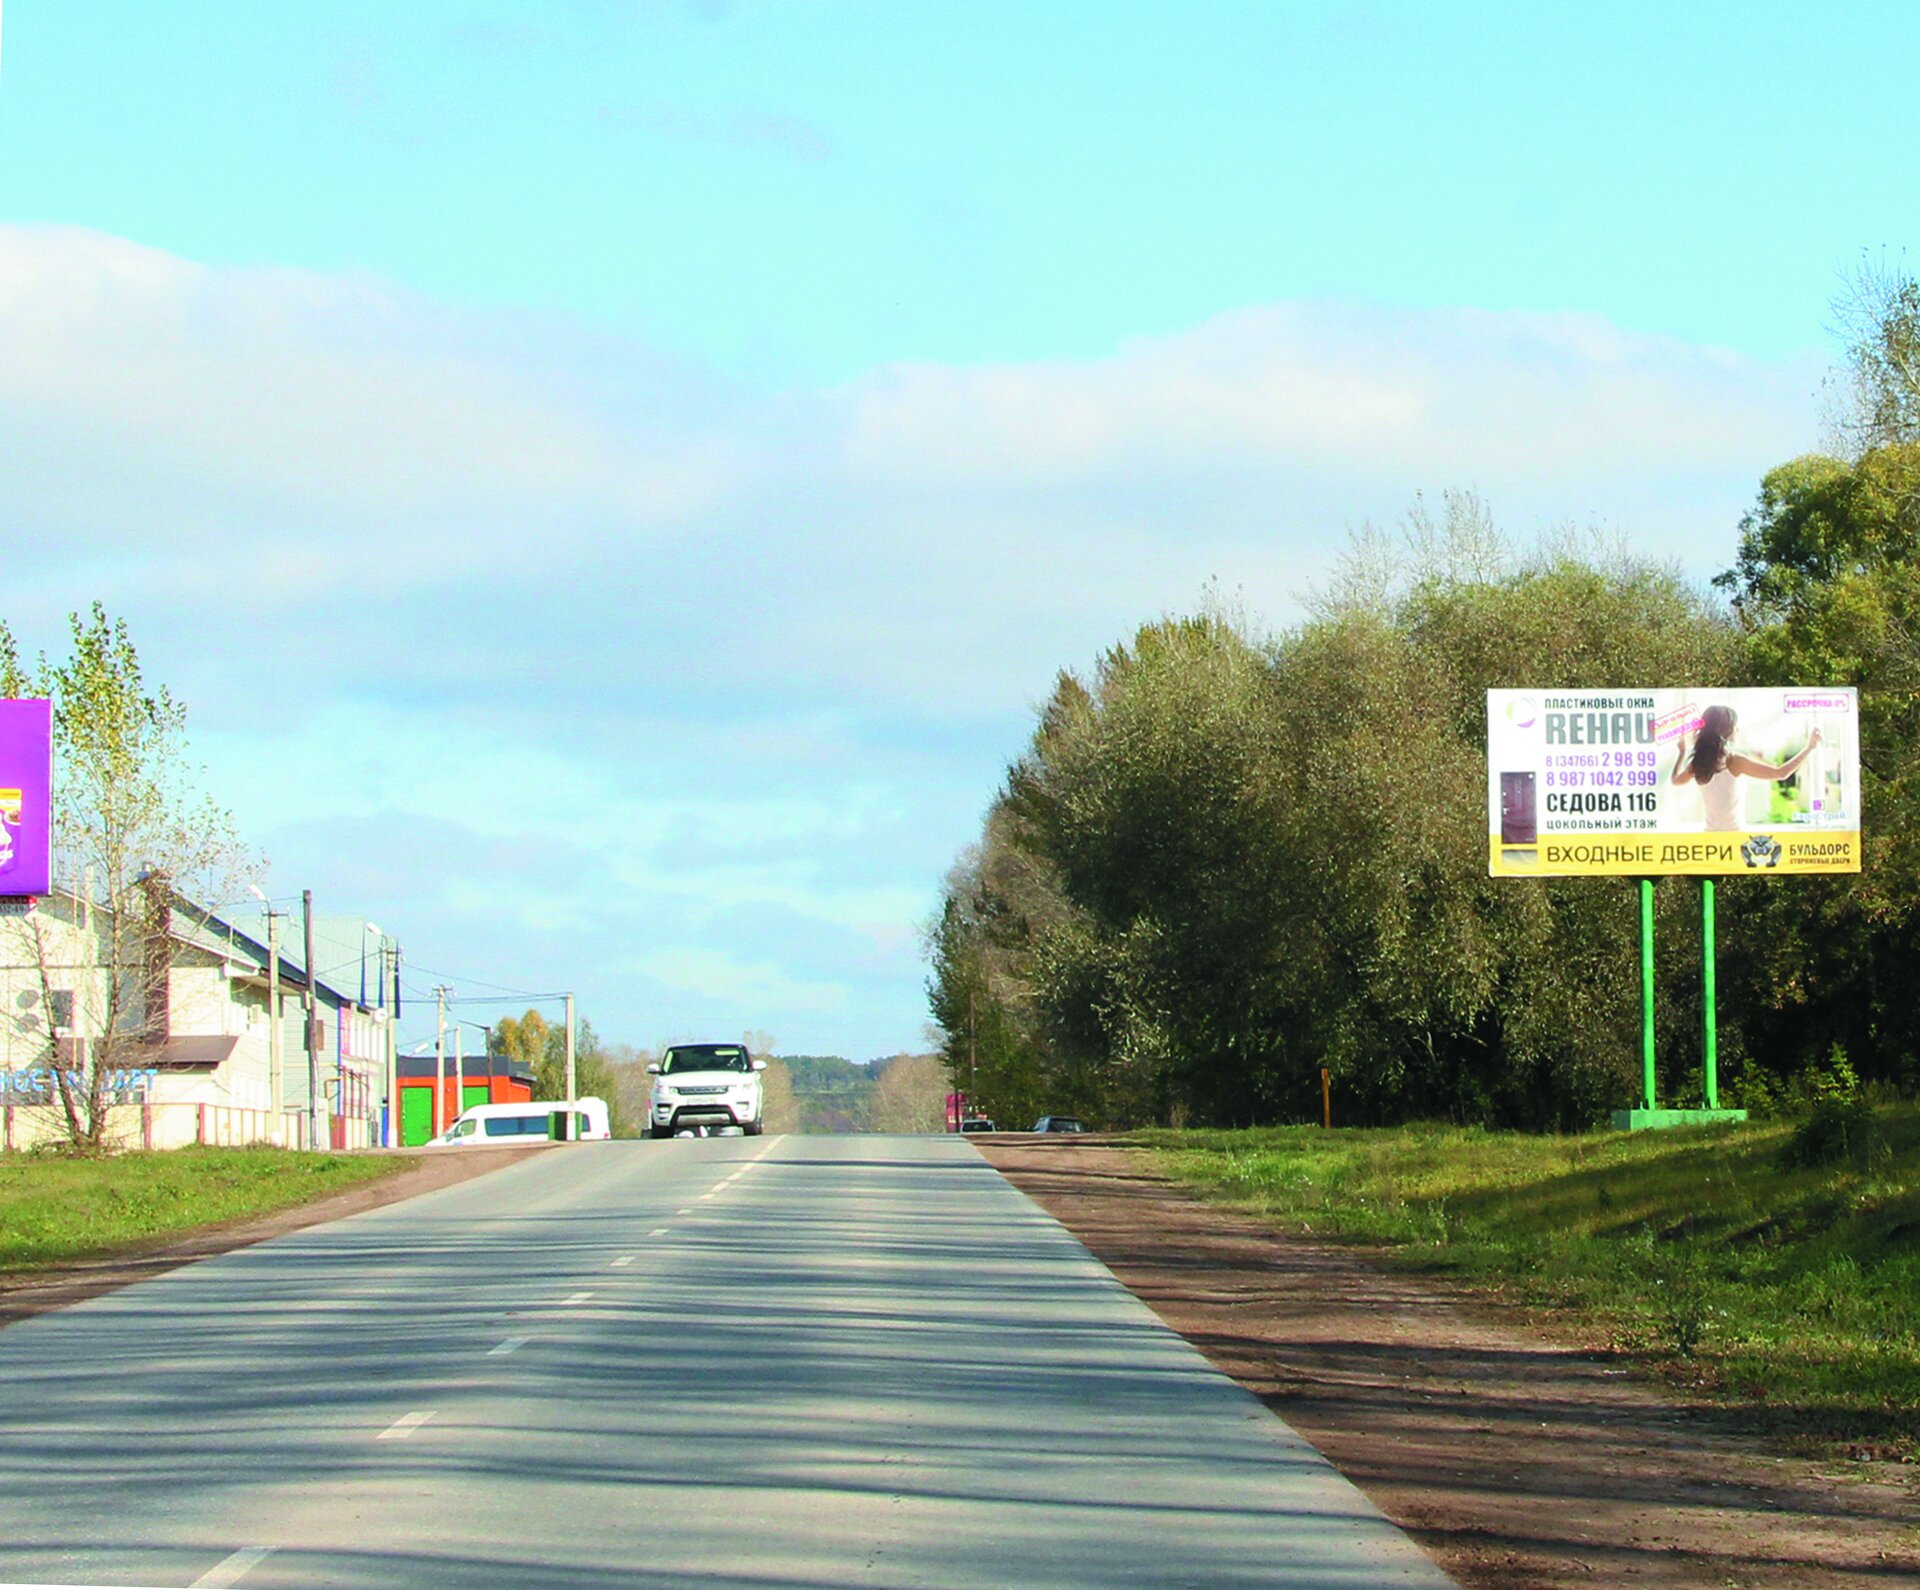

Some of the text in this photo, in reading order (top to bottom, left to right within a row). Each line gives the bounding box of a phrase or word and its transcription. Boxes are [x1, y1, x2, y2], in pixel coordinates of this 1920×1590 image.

[1544, 697, 1655, 709] ПЛАСТИКОВЫЕ ОКНА
[1545, 713, 1656, 744] REHAU
[1545, 751, 1656, 767] 8 (34766) 2 98 99
[1546, 770, 1657, 786] 8 987 1042 999
[1546, 792, 1657, 815] СЕДОВА 116
[1546, 844, 1733, 864] ВХОДНЫЕ ДВЕРИ
[1789, 843, 1850, 856] БУЛЬДОРС
